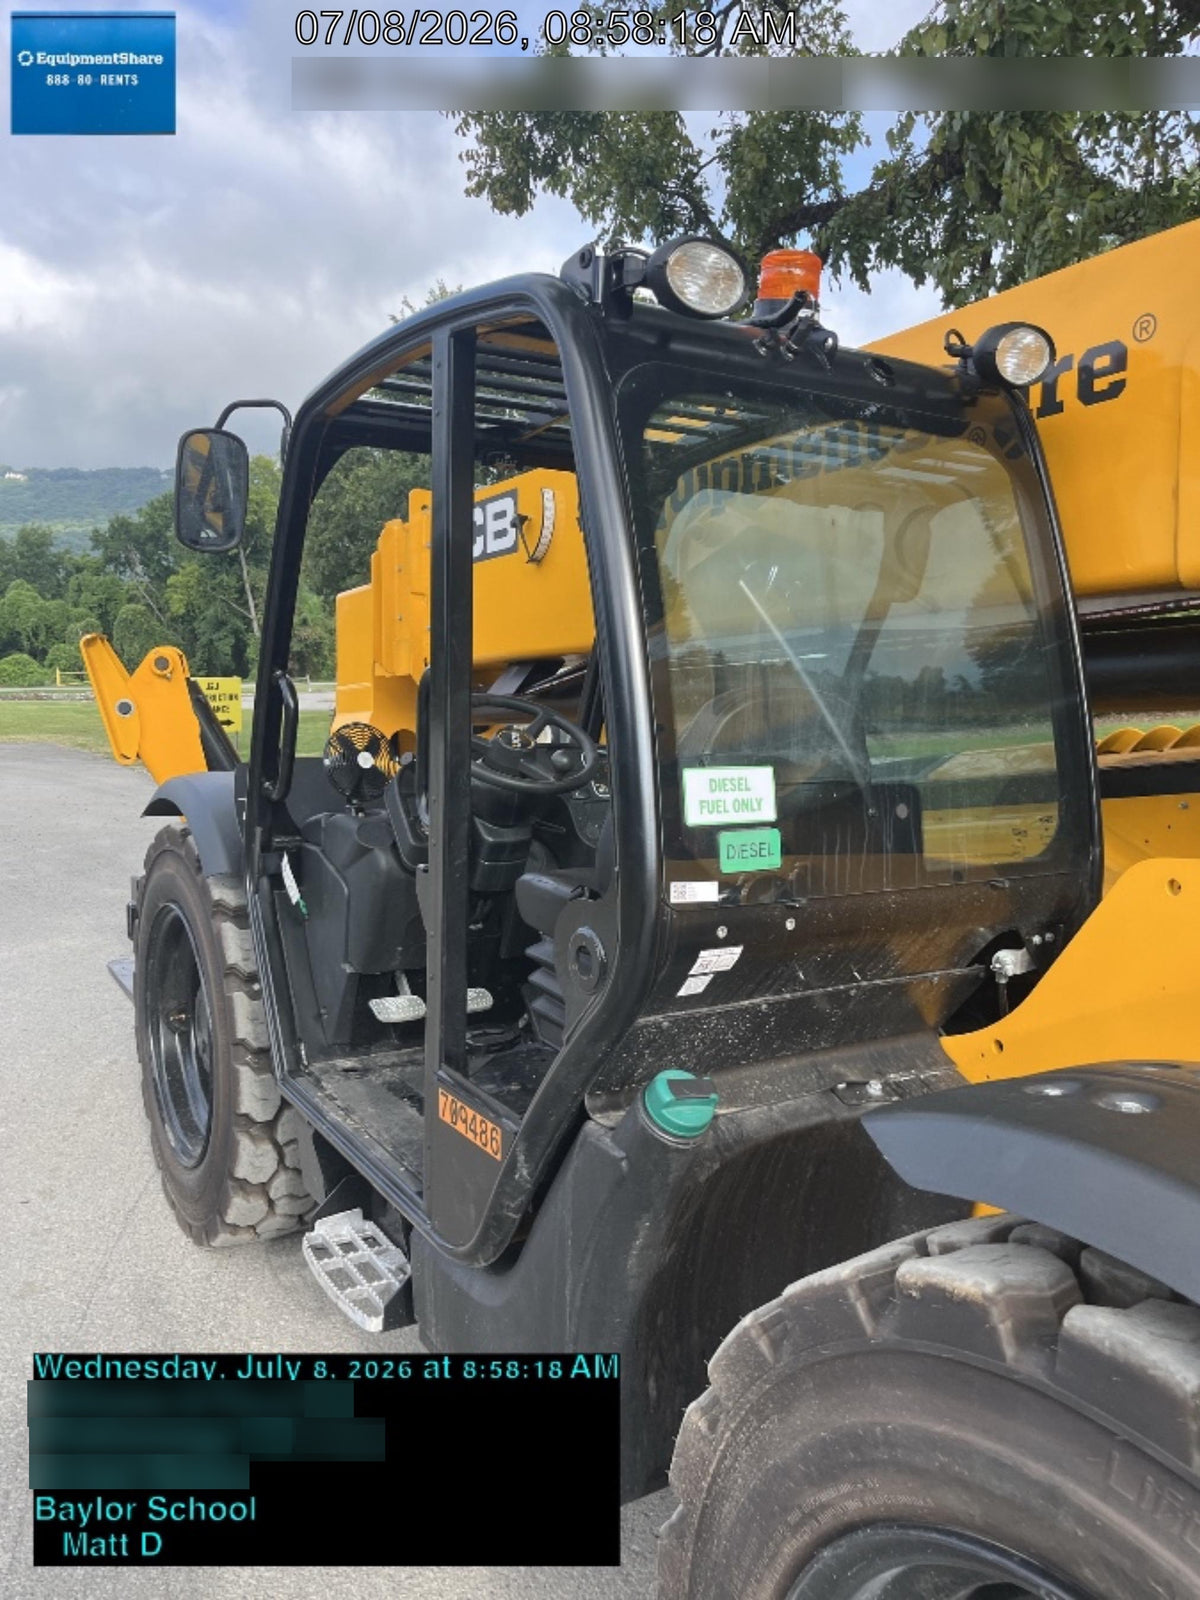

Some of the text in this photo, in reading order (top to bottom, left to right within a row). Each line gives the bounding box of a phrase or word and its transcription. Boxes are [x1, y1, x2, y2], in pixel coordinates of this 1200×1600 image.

[709, 777, 752, 793] DIESEL
[699, 798, 763, 815] FUEL ONLY
[727, 842, 775, 860] DIESEL
[440, 1091, 500, 1155] 709486
